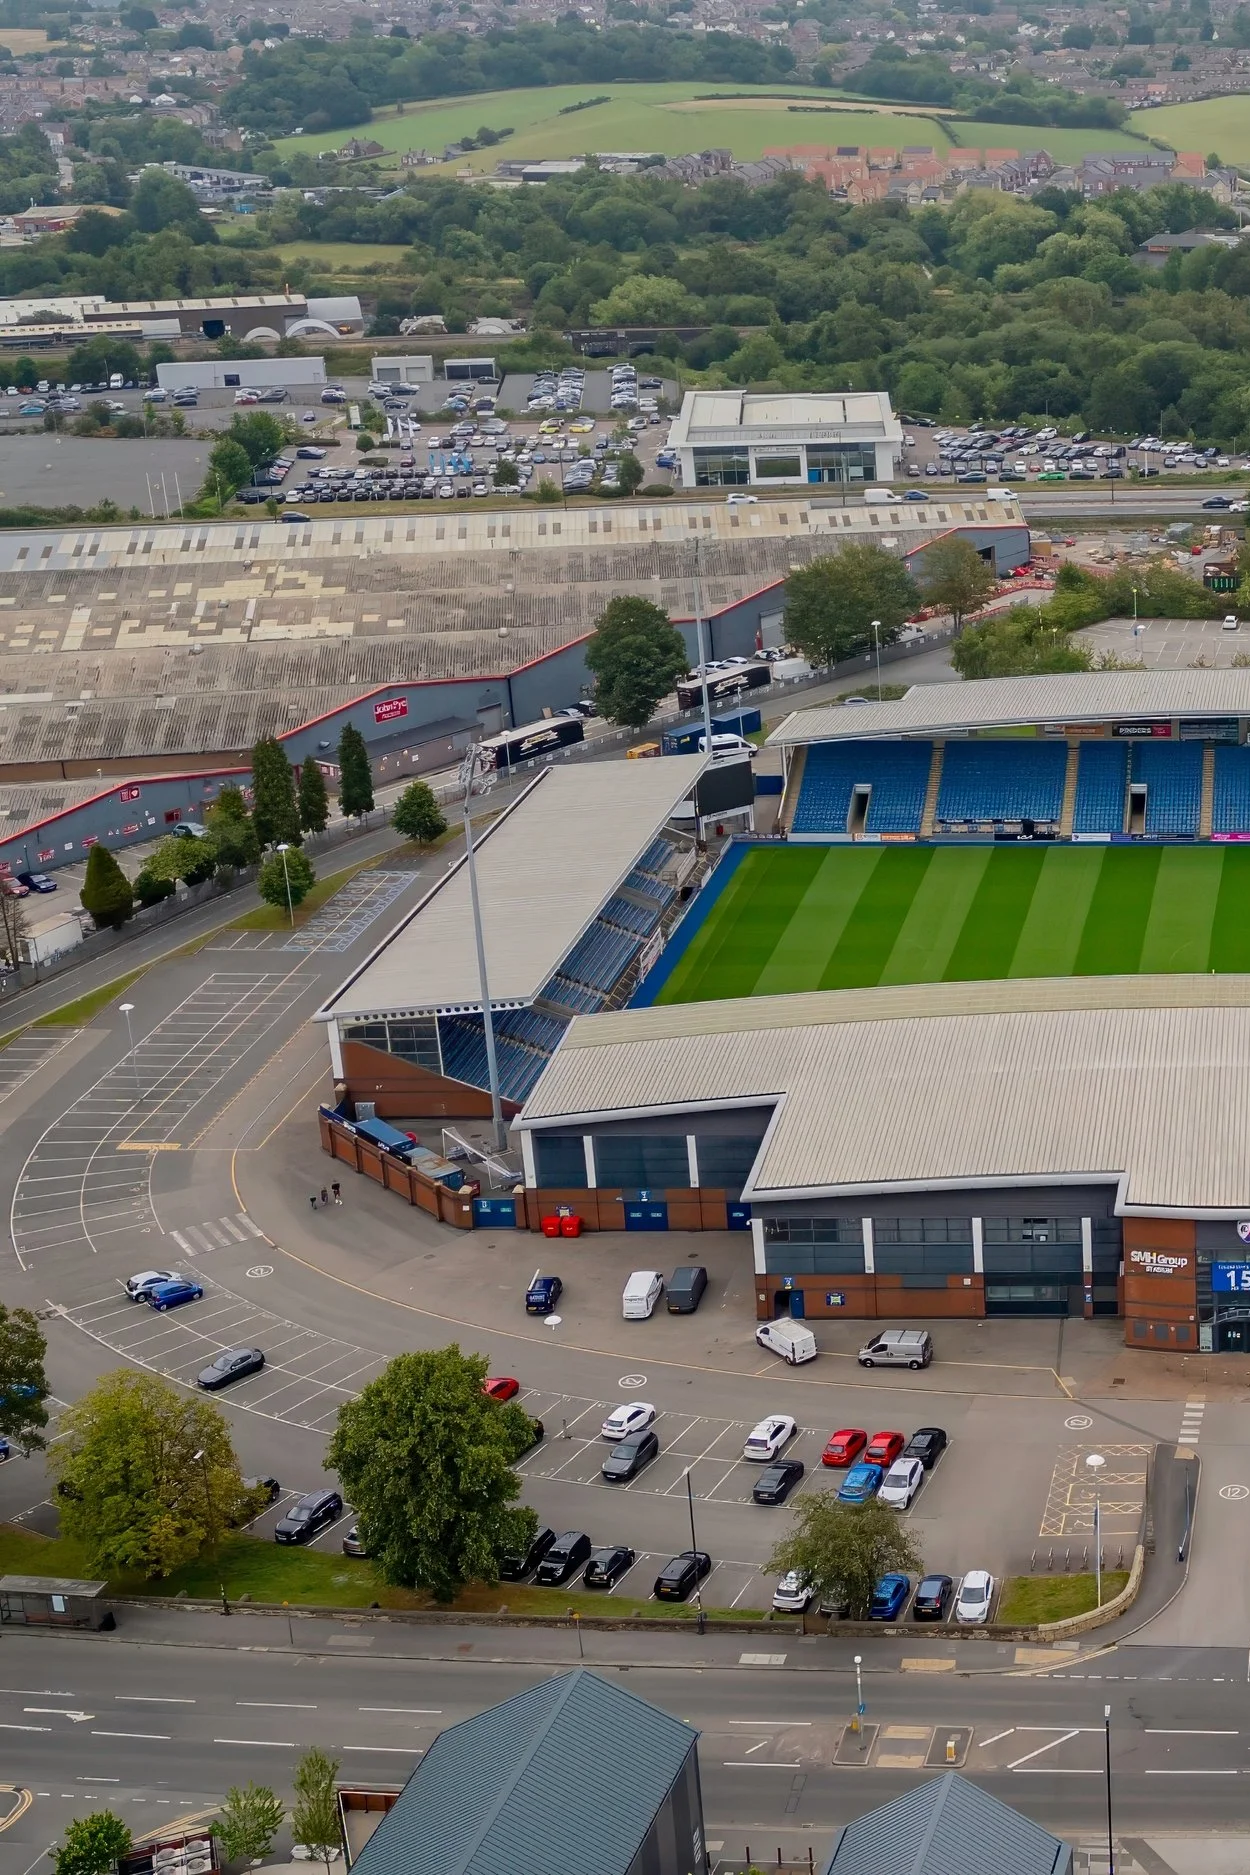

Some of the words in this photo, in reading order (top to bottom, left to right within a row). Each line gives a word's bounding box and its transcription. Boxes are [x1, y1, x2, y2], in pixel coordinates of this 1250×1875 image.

[1130, 1251, 1157, 1264] SMH
[1157, 1254, 1188, 1268] Group
[1227, 1487, 1241, 1497] 12
